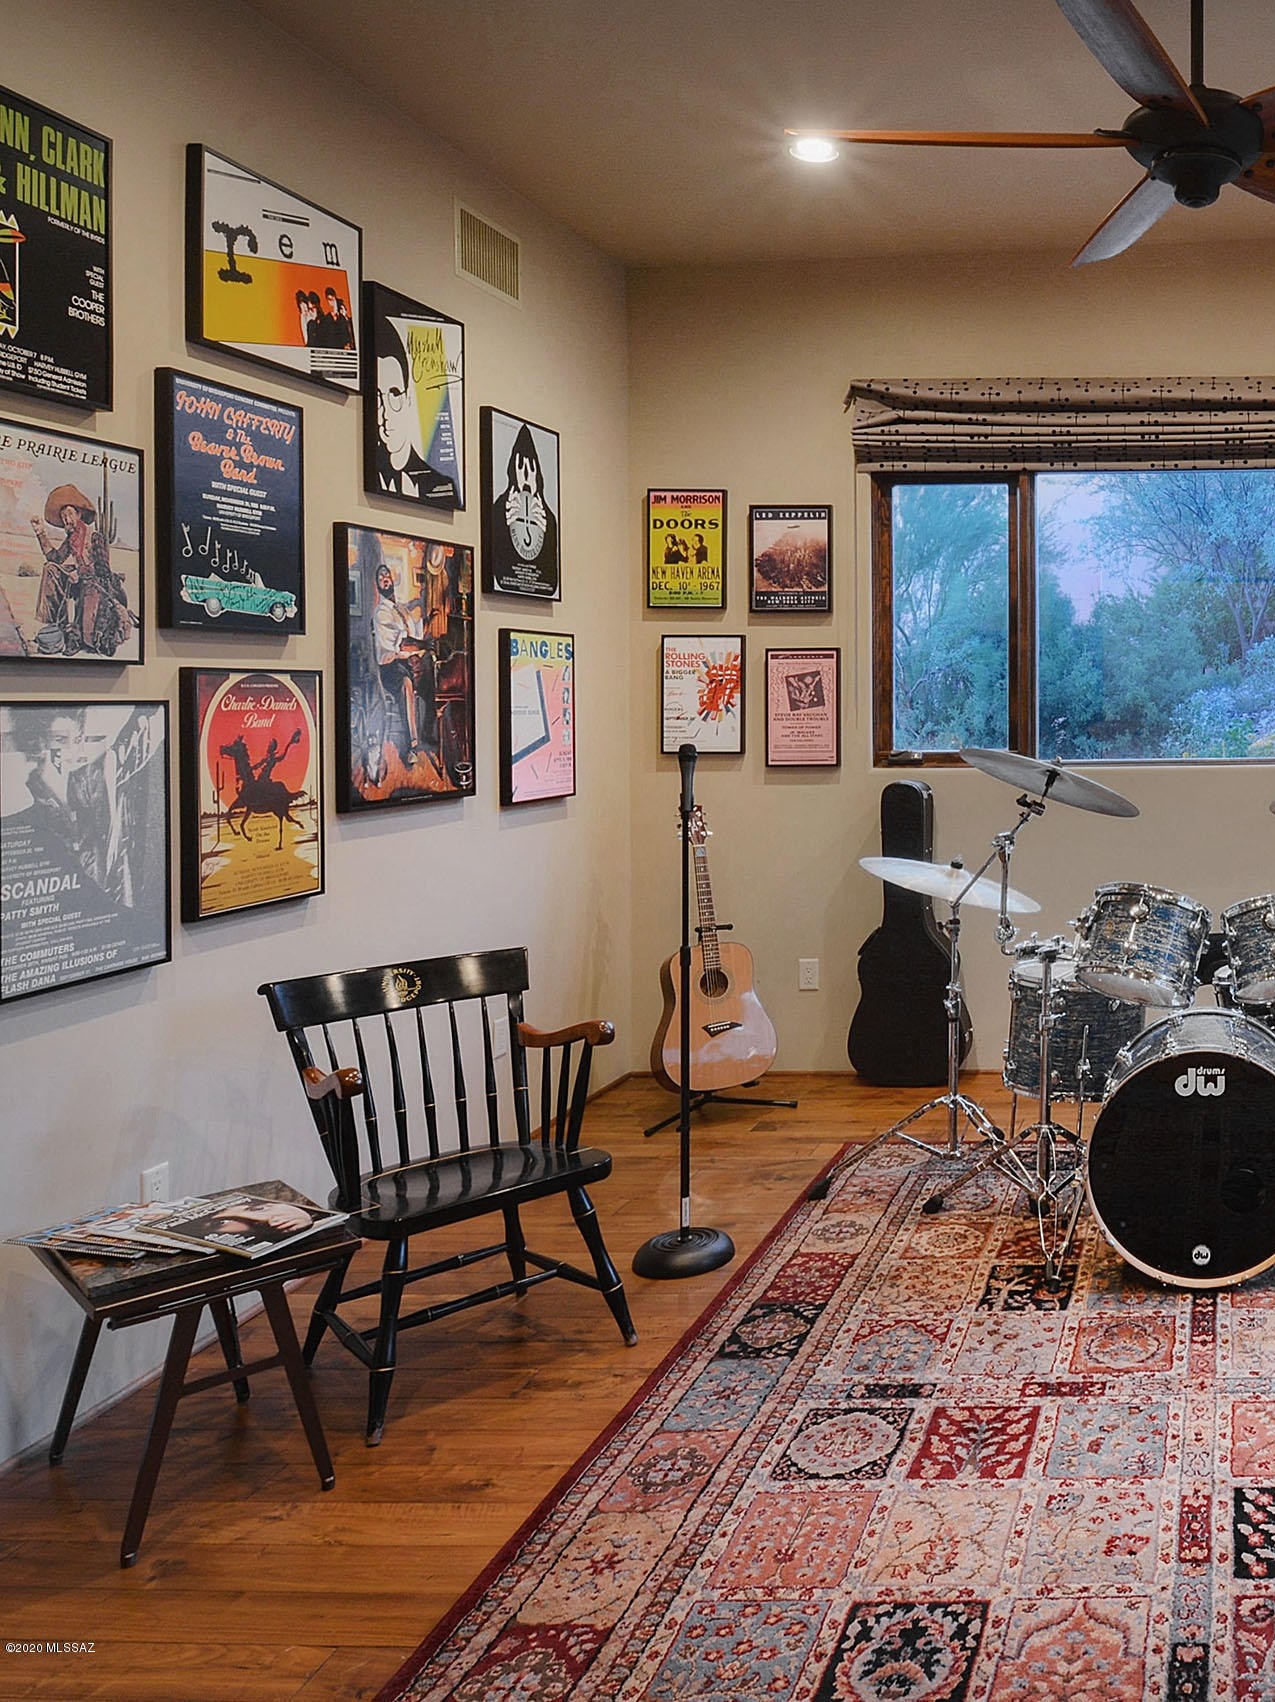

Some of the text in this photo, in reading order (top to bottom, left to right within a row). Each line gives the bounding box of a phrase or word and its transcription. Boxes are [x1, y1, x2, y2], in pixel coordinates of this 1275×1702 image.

[41, 125, 105, 188] CLARK
[16, 162, 105, 234] HILLMAN
[71, 295, 105, 314] COOPER
[91, 289, 105, 303] THE
[68, 306, 106, 327] BROTHERS
[176, 390, 296, 445] JOHN CAFFERTY
[16, 438, 78, 463] PRAIRIE
[80, 452, 137, 474] LEAGUE
[220, 459, 258, 484] Band
[651, 494, 721, 505] JIM MORRISON
[652, 518, 719, 530] DOORS
[651, 566, 720, 580] NEW HAVEN ARENA
[651, 581, 673, 591] DEC.
[699, 581, 721, 591] 1967
[510, 638, 573, 660] BANGLES
[665, 652, 706, 660] ROLLING
[665, 660, 701, 668] STONES
[220, 694, 298, 711] Charlie Daniels
[241, 712, 276, 729] Band
[1, 873, 81, 901] SCANDAL
[21, 894, 55, 906] FEATURING
[29, 903, 60, 917] SMYTH
[21, 912, 82, 929] WITH SPECIAL GUEST
[1, 955, 18, 967] THE
[20, 942, 75, 963] COMMUTERS
[1, 972, 18, 984] THE
[19, 962, 60, 980] AMAZING
[61, 952, 105, 970] ILLUSIONS
[105, 949, 119, 960] OF
[31, 974, 57, 988] DANA
[1196, 1065, 1226, 1075] drums
[1174, 1067, 1226, 1097] dw
[1193, 1250, 1209, 1260] dw
